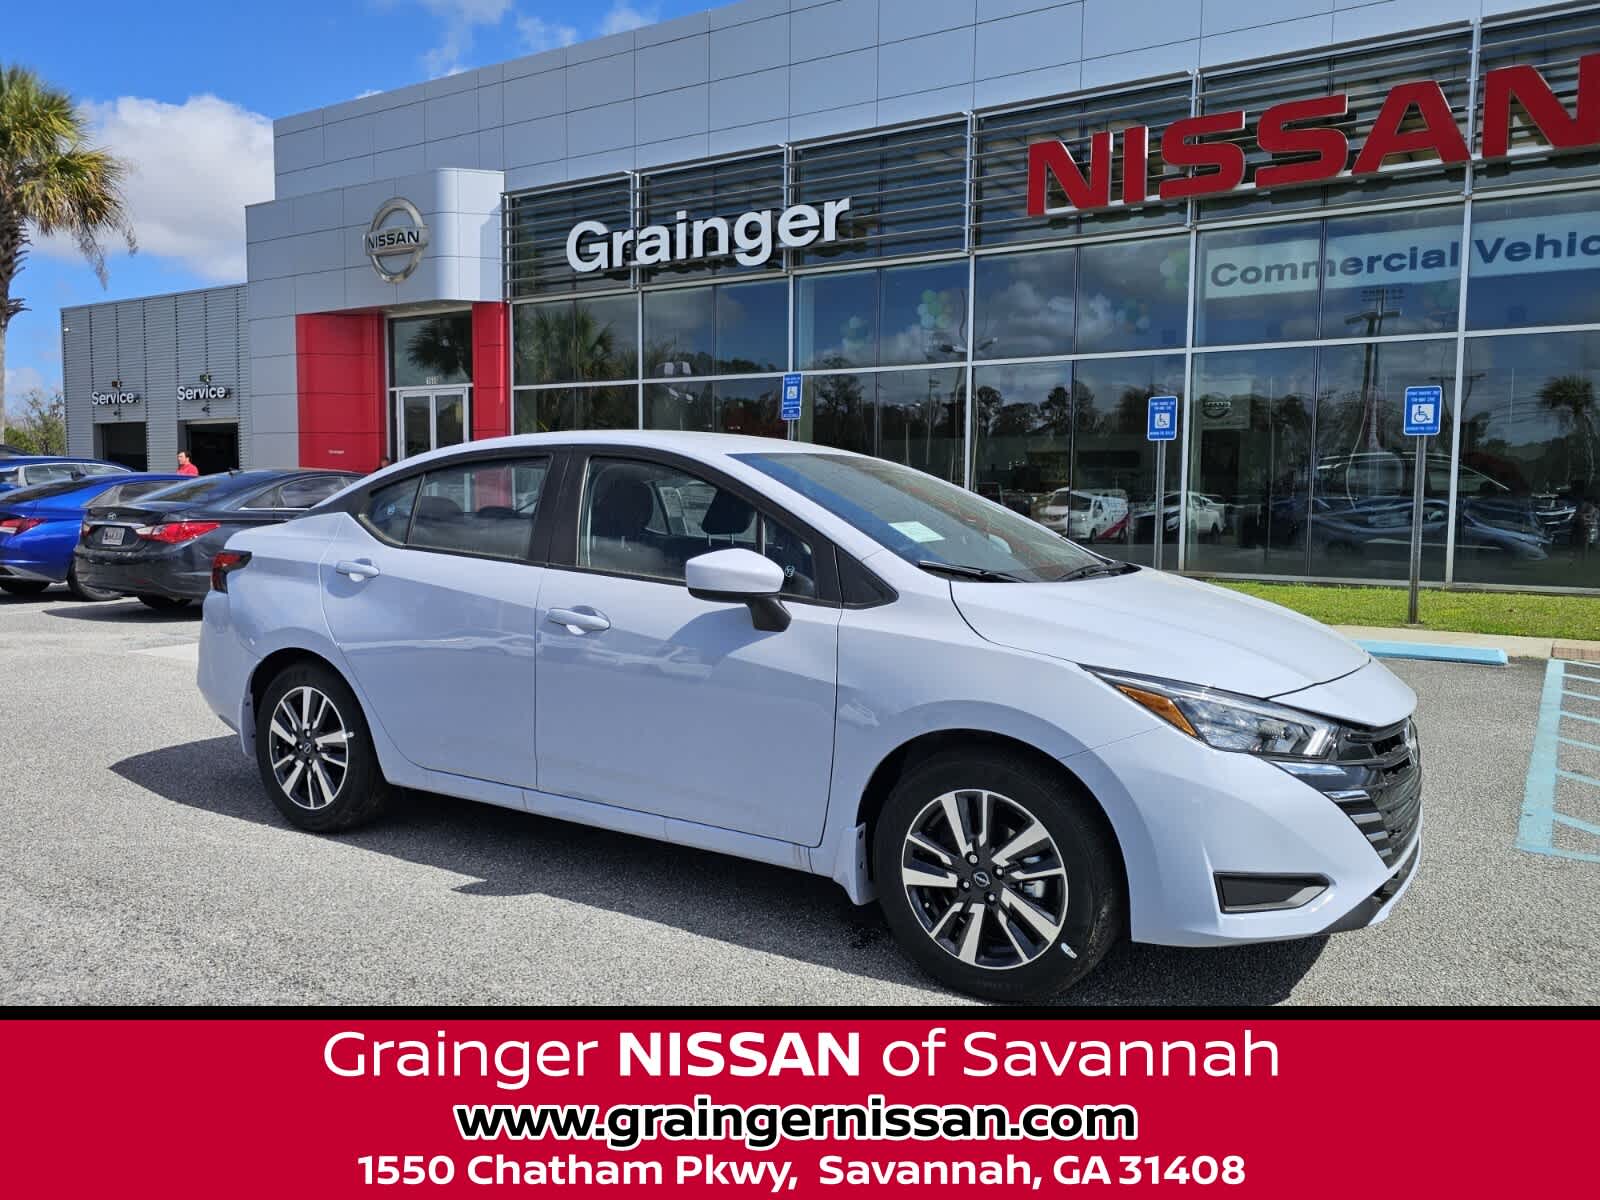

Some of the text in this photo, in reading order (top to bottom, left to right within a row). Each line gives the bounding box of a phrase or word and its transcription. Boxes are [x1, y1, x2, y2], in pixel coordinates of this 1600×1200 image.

[1027, 51, 1600, 216] NISSAN
[368, 230, 420, 249] NISSAN
[566, 197, 850, 272] Grainger
[1210, 241, 1460, 287] Commercial
[91, 391, 135, 405] Service
[177, 384, 226, 400] Service
